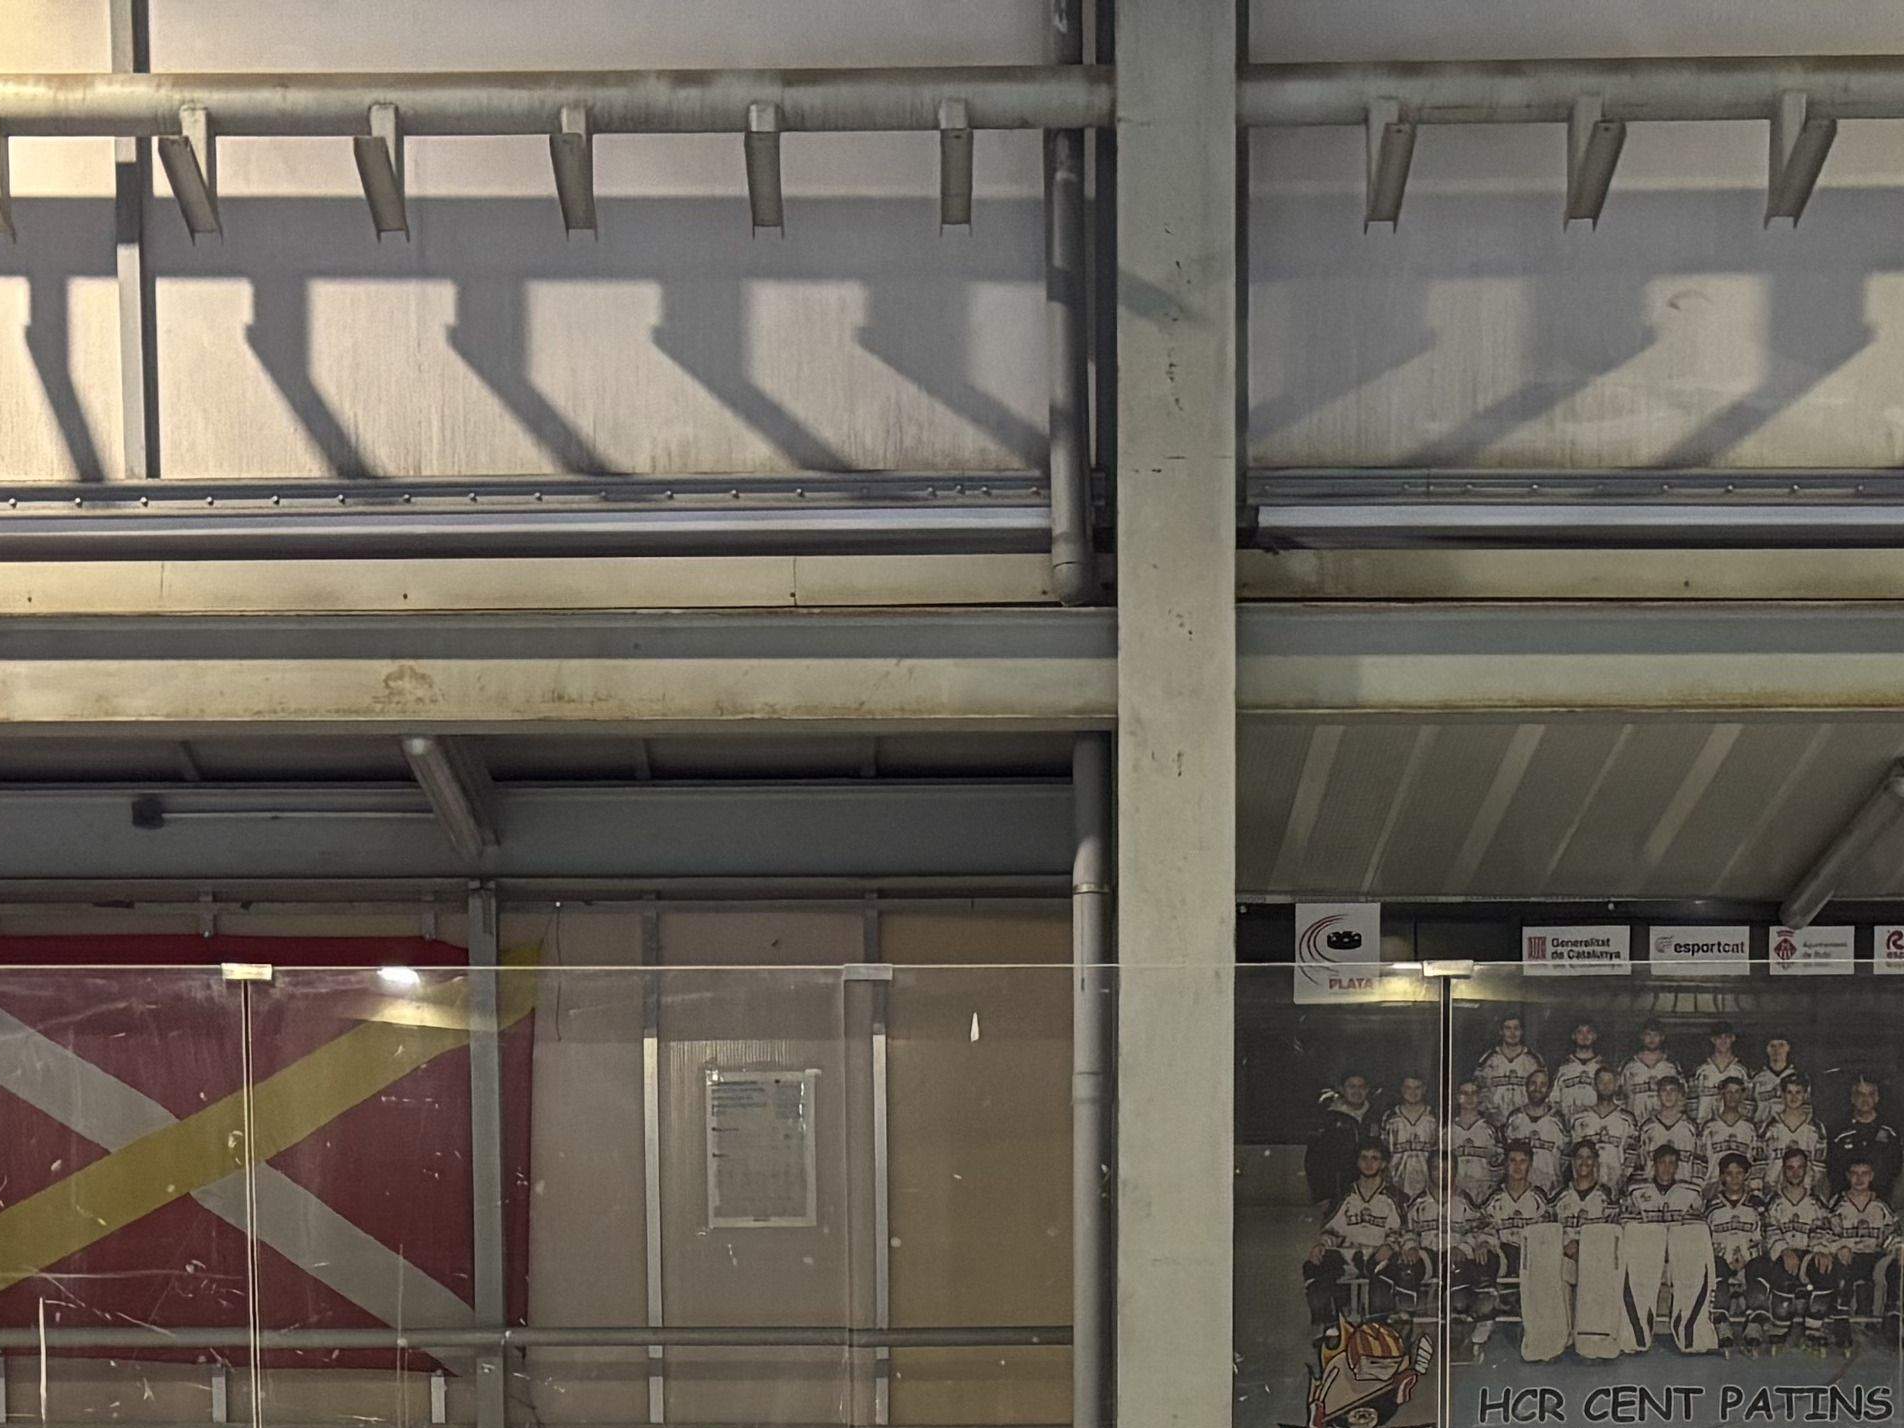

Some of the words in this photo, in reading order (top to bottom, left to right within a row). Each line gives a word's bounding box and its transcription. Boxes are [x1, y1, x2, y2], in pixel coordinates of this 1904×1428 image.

[1328, 977, 1375, 991] PLATA
[1478, 1385, 1566, 1424] HCR
[1582, 1384, 1706, 1424] CENT
[1718, 1384, 1896, 1424] PATINS
